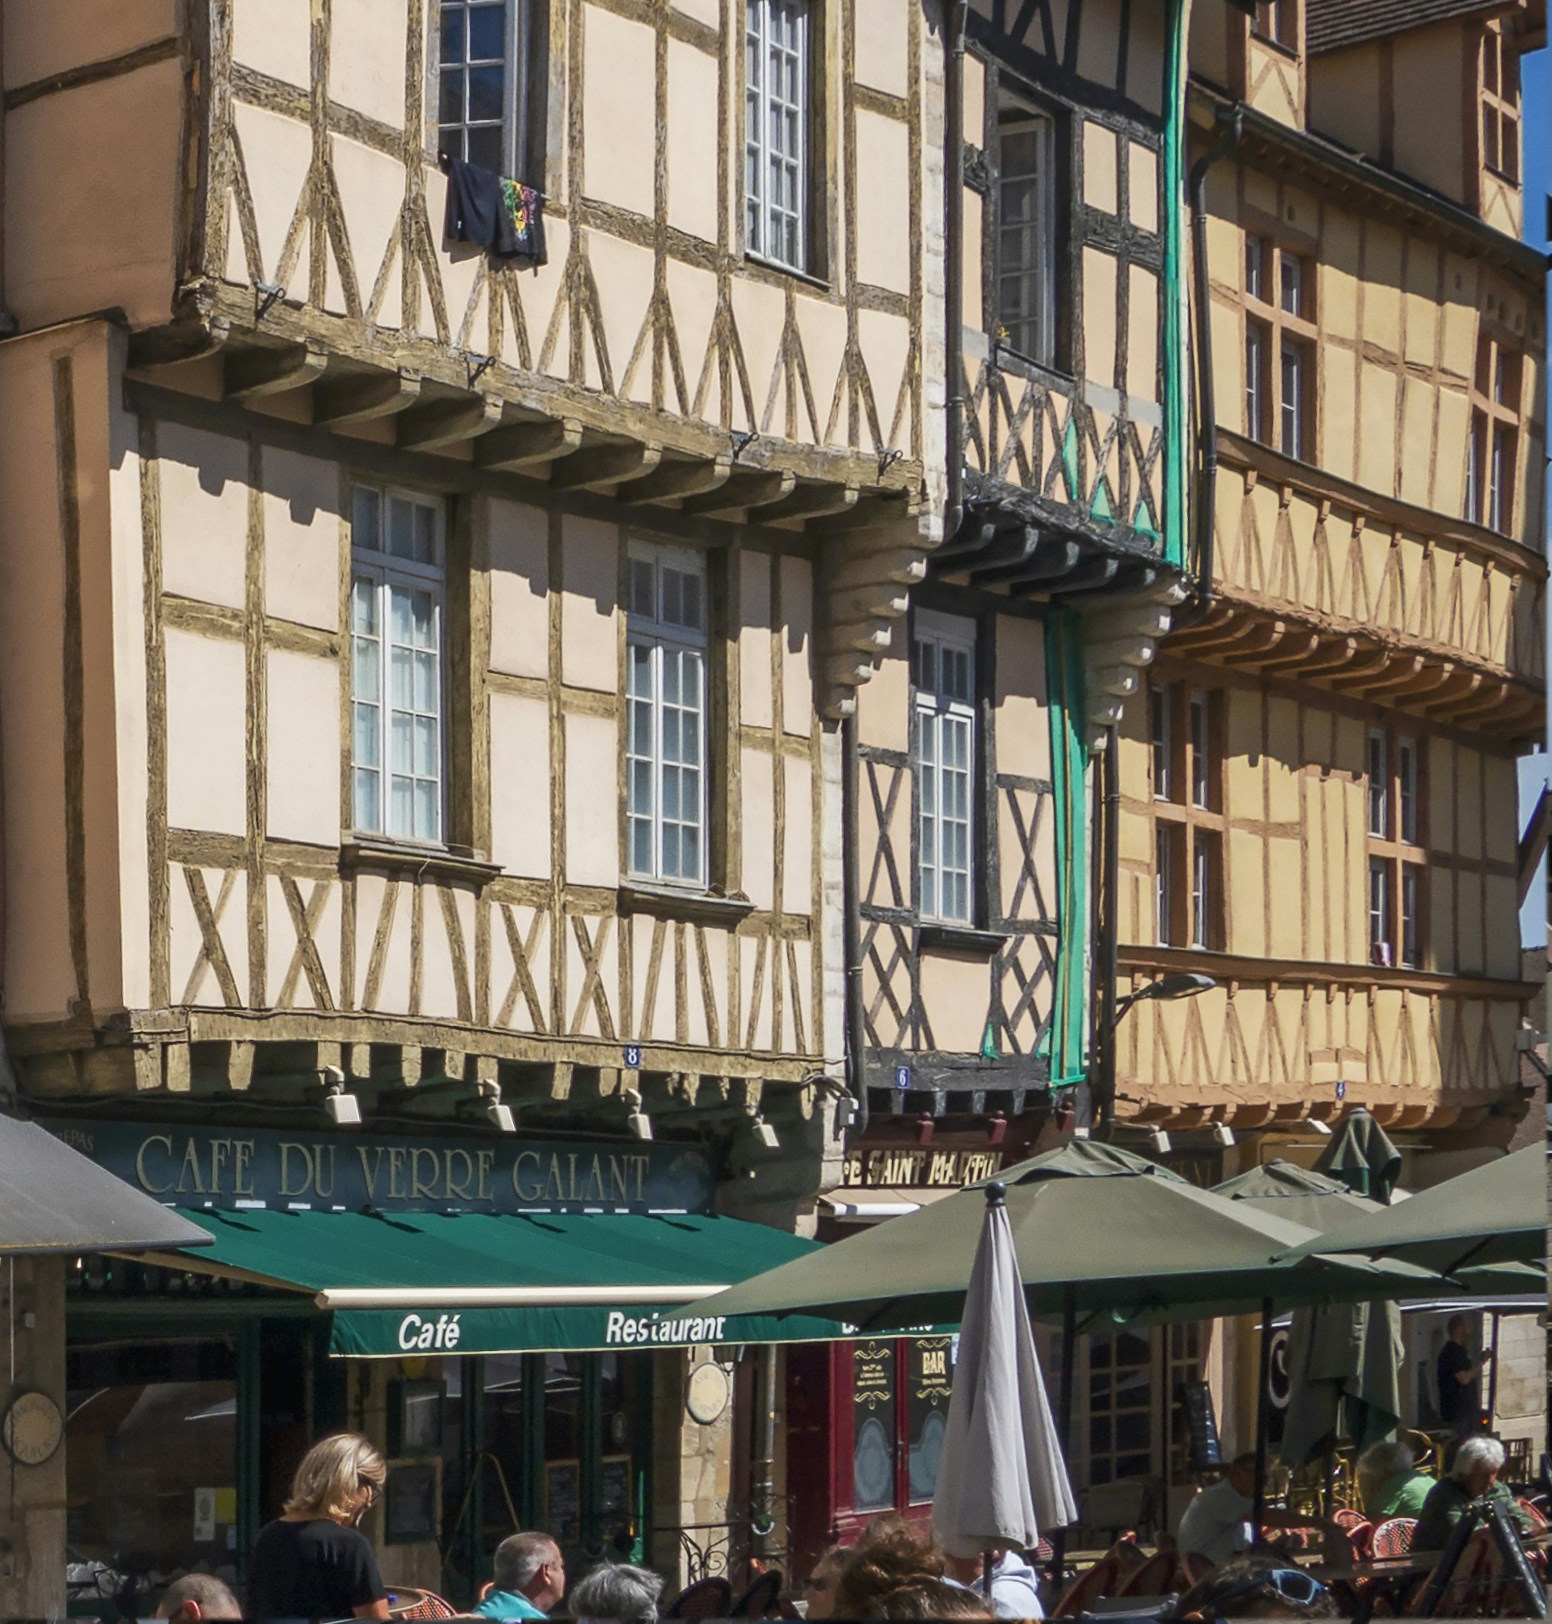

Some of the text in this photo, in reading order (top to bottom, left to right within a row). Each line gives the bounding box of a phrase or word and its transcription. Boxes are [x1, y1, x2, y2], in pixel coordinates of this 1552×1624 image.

[135, 1134, 255, 1197] CAFE
[277, 1142, 336, 1198] DU
[355, 1145, 495, 1201] VERRE
[511, 1150, 649, 1203] GALANT
[867, 1149, 927, 1186] SAINT
[397, 1310, 726, 1351] Café Restaurant
[922, 1351, 947, 1375] BAR
